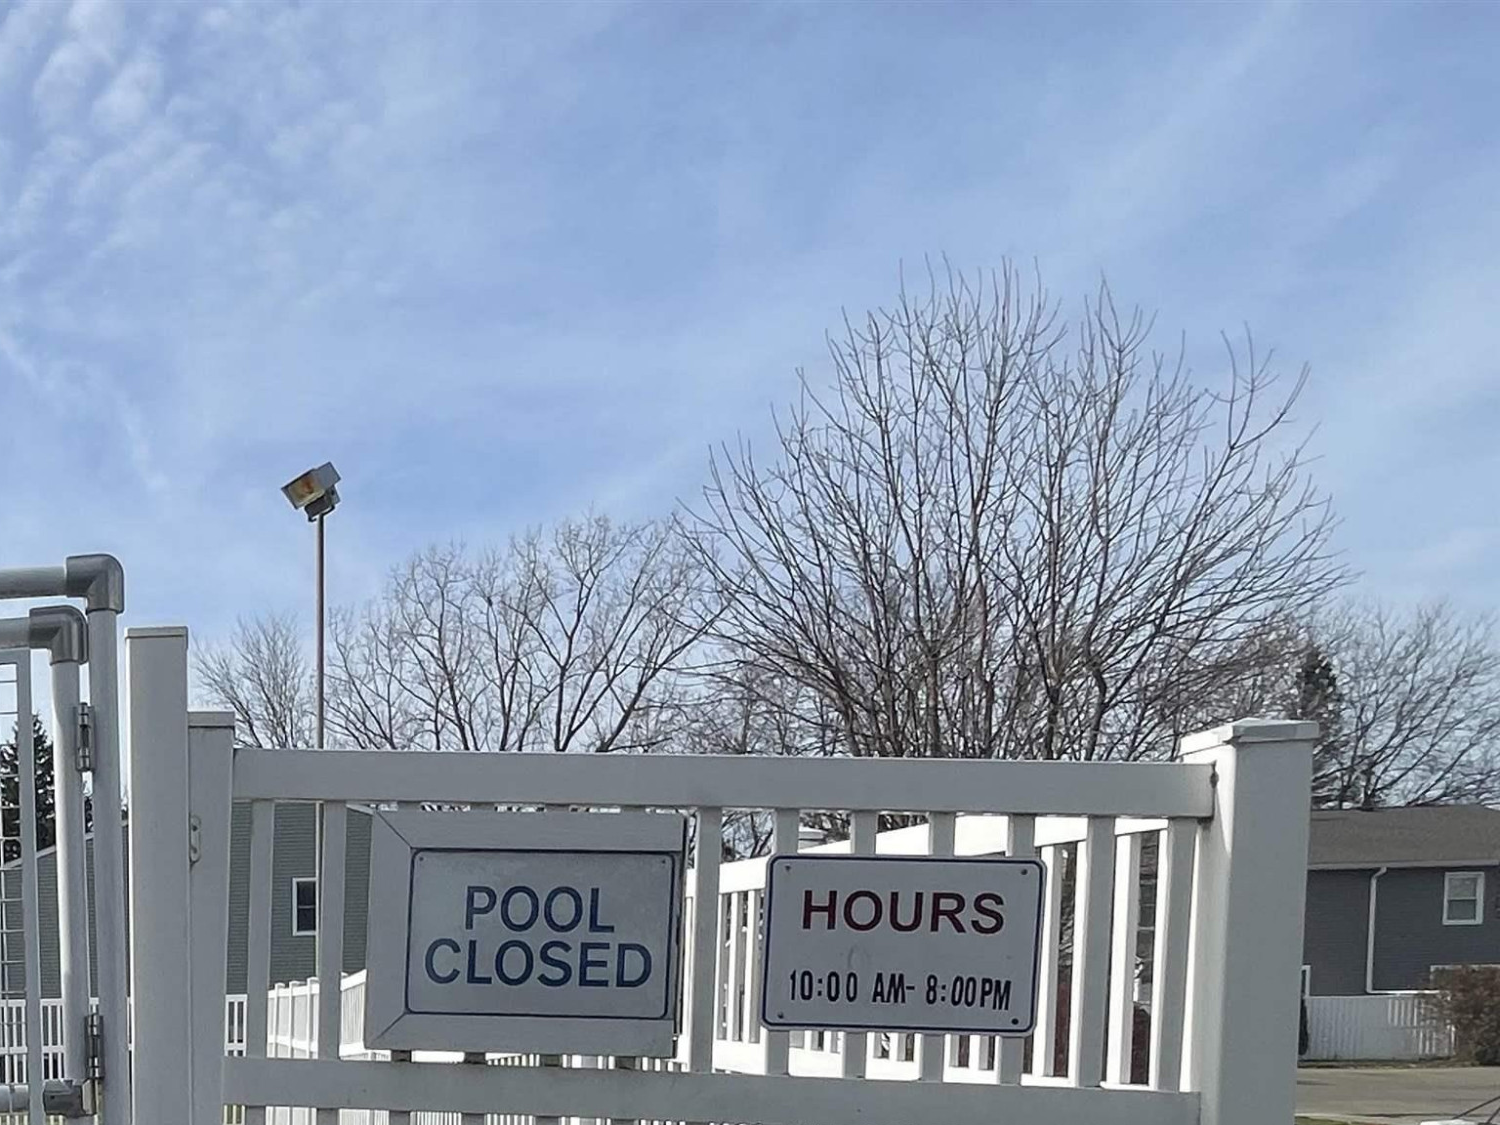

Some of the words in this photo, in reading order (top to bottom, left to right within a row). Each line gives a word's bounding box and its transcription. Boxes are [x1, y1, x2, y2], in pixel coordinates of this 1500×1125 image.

[464, 885, 615, 933] POOL
[801, 889, 1005, 935] HOURS
[424, 937, 652, 987] CLOSED
[789, 969, 858, 1002] 10:00
